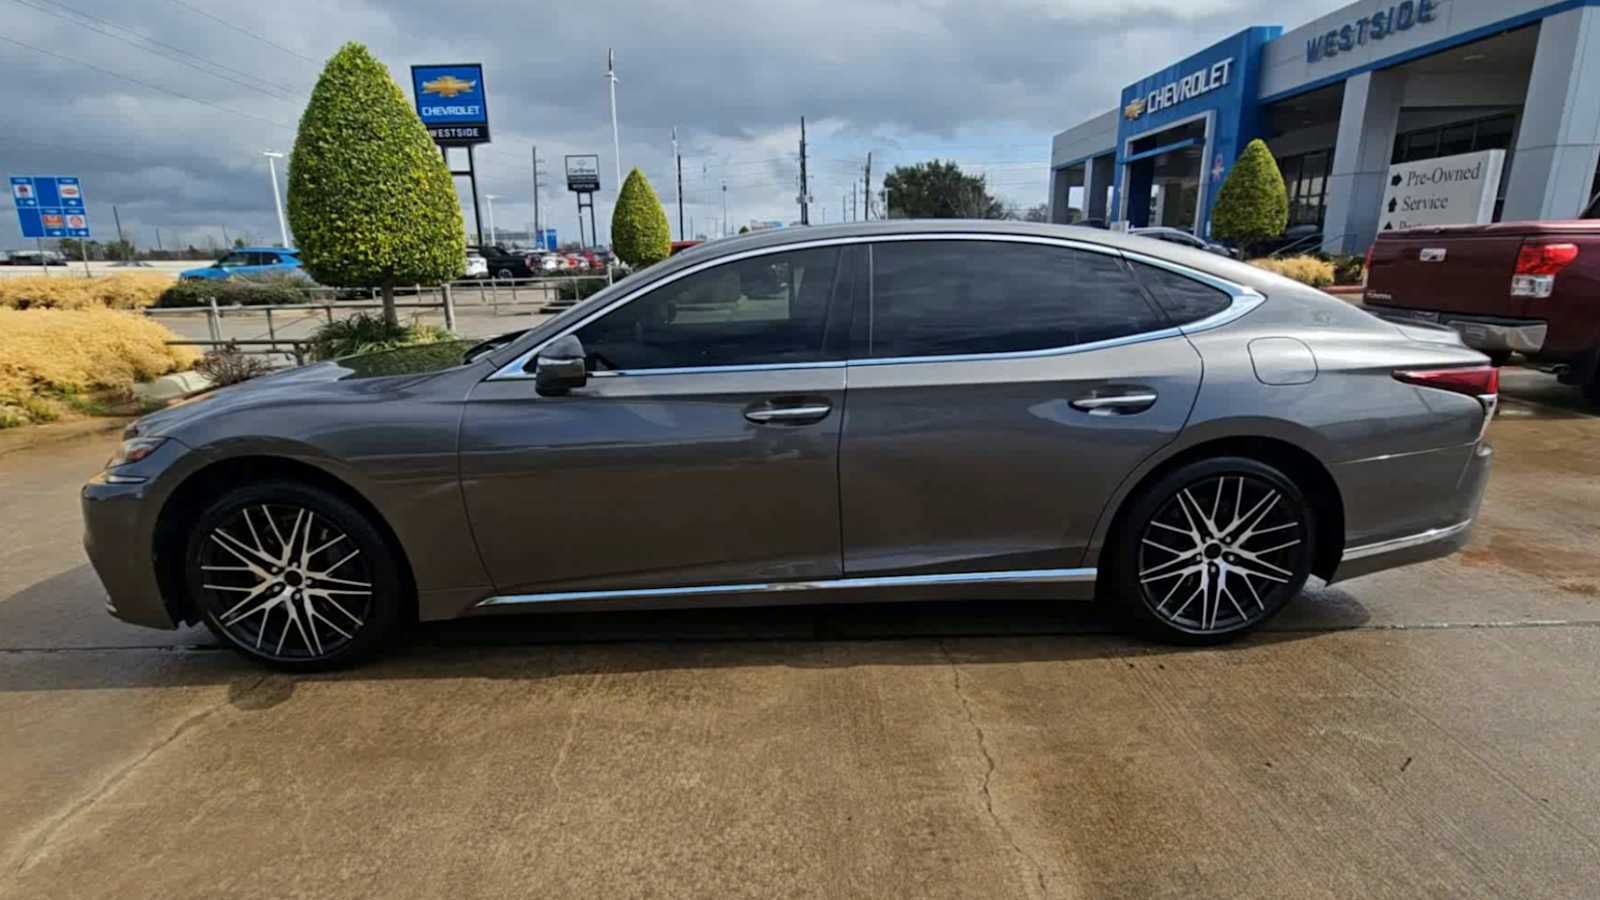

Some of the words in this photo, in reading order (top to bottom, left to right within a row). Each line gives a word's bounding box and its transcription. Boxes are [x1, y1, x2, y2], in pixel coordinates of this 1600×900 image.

[1306, 0, 1437, 63] WESTSIDE
[1147, 57, 1234, 114] CHEVROLET
[421, 105, 480, 116] CHEVROLET
[1407, 161, 1481, 187] Pre-Owned
[1401, 195, 1449, 212] Service
